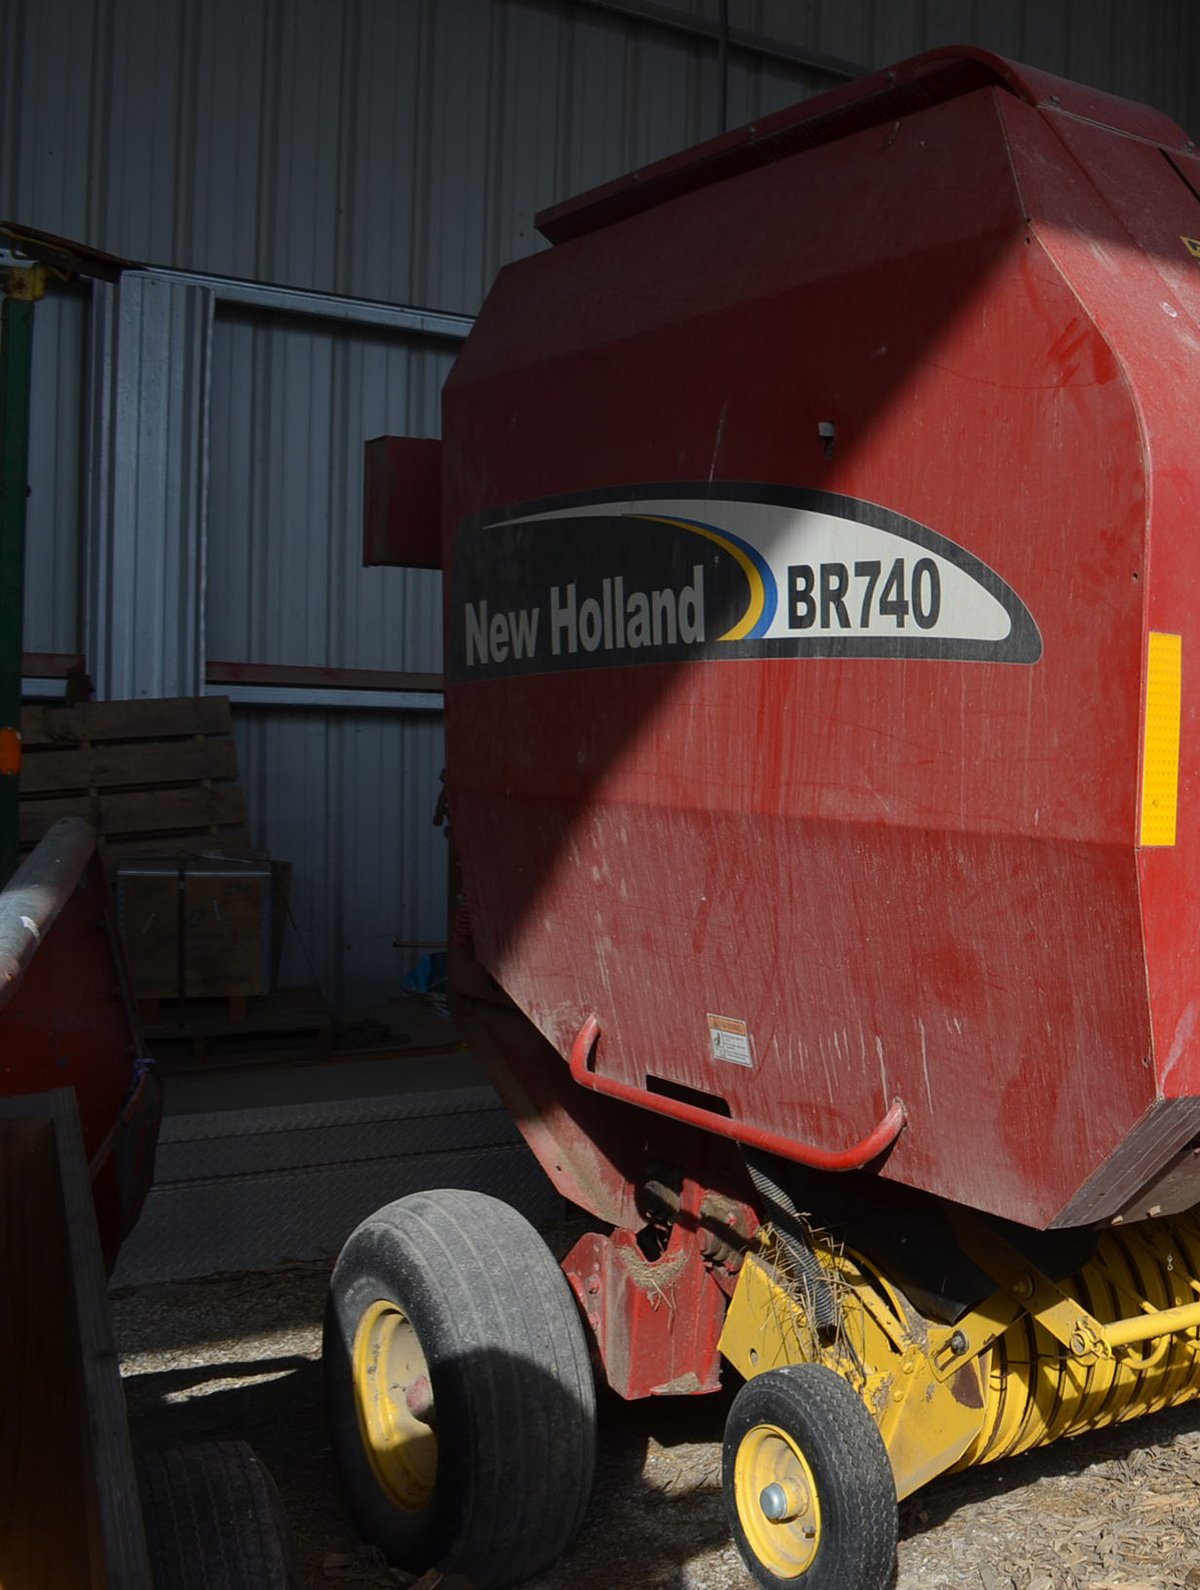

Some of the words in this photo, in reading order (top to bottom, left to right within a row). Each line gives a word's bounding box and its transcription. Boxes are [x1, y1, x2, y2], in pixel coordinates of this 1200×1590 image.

[464, 600, 541, 667] New
[550, 564, 706, 656] Holland
[787, 557, 941, 630] BR740
